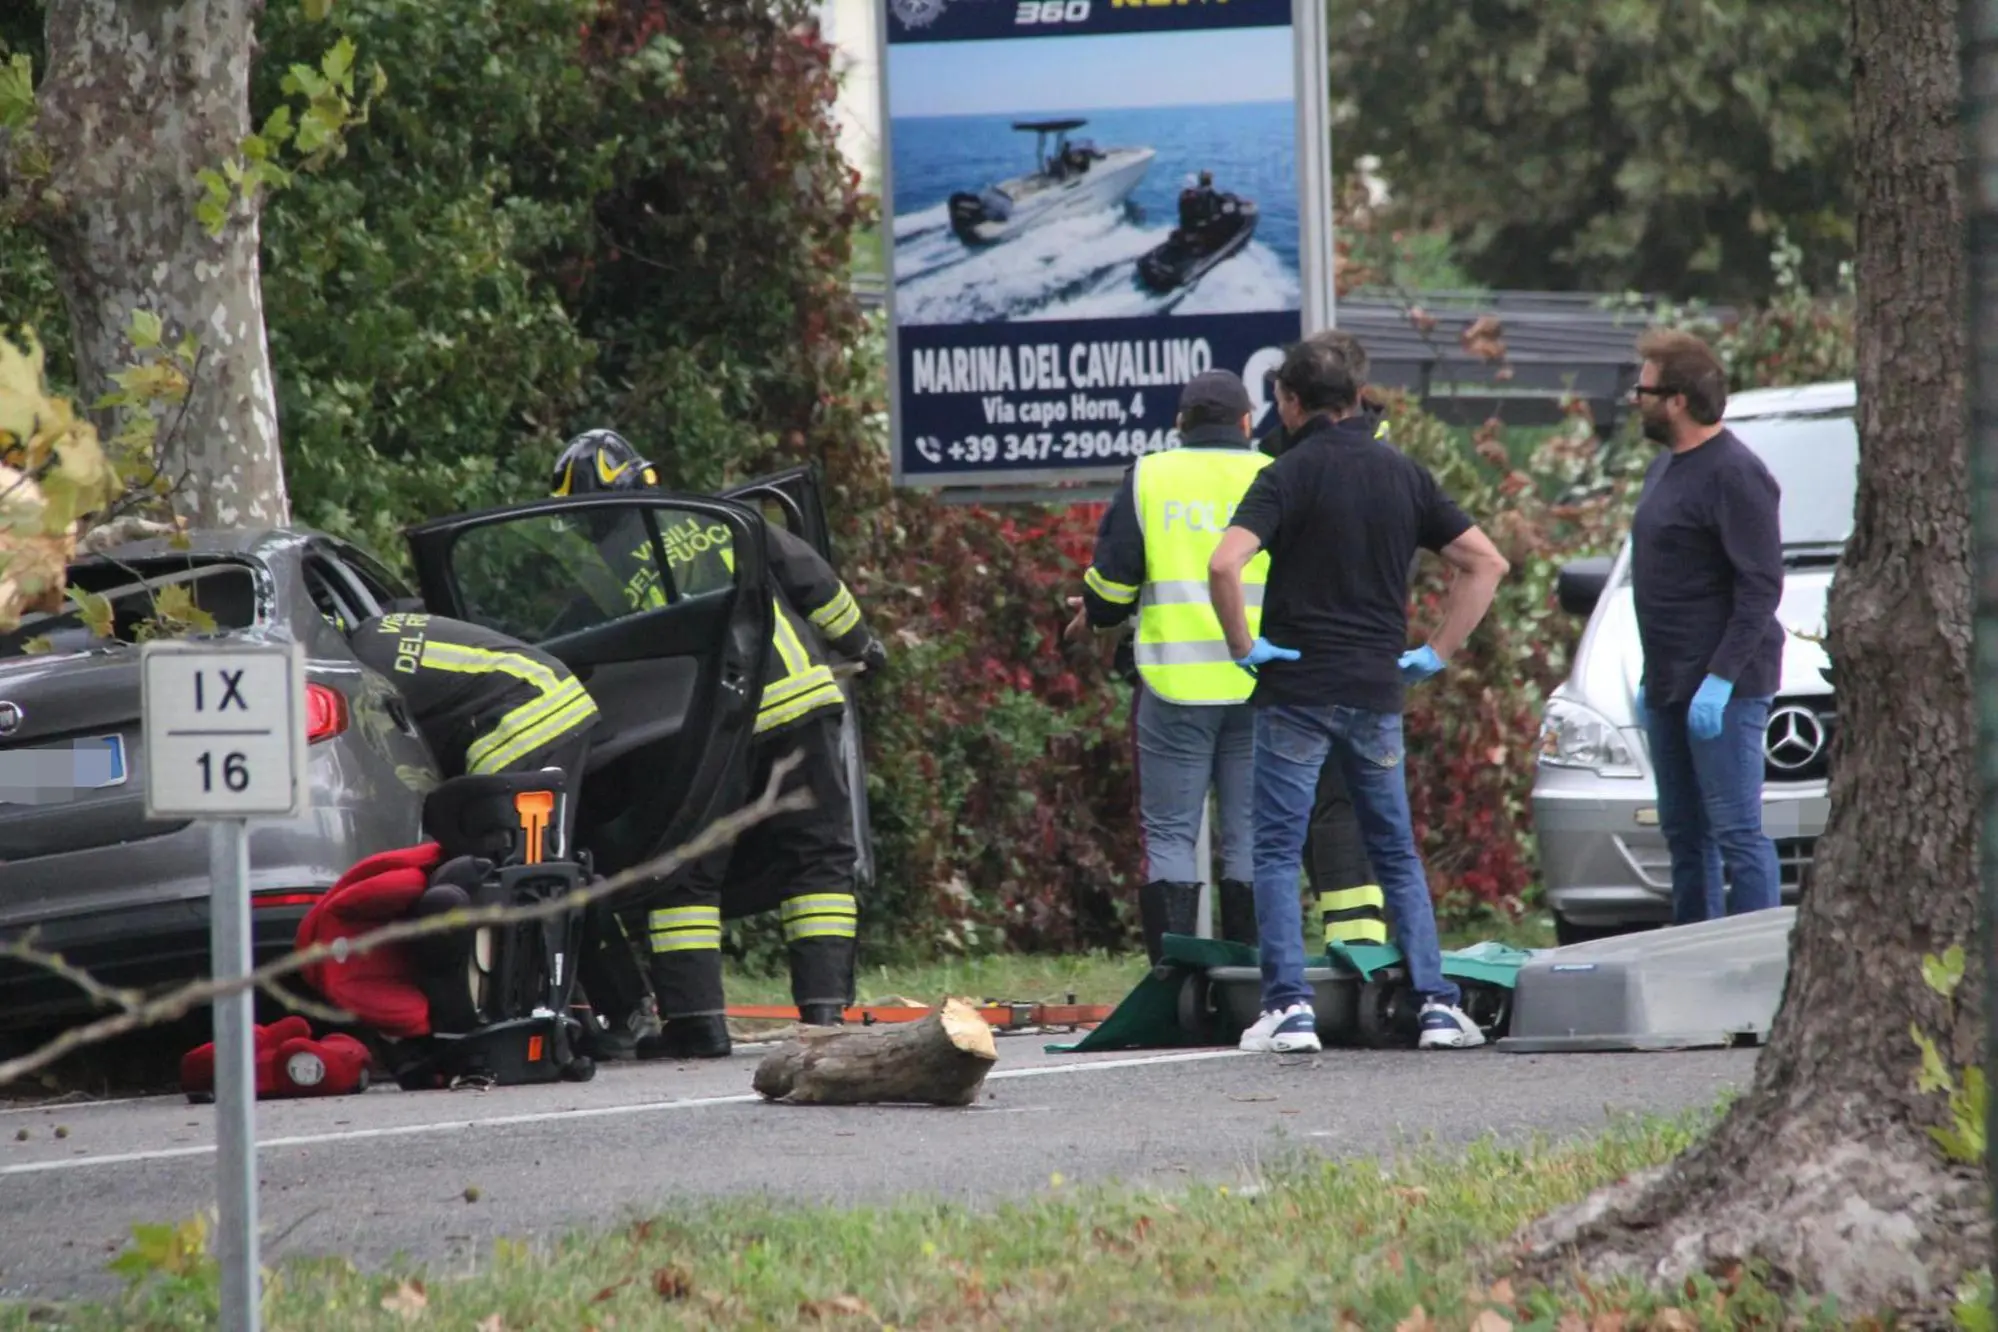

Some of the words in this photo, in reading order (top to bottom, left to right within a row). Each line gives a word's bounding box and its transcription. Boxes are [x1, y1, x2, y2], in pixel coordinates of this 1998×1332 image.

[1014, 0, 1091, 25] 360
[913, 345, 1016, 394] MARINA
[1018, 342, 1067, 391] DEL
[1069, 337, 1212, 389] CAVALLINO
[982, 394, 1016, 424] Via
[1019, 400, 1068, 429] capo
[1071, 392, 1127, 425] Horn,
[1130, 391, 1145, 419] 4
[947, 433, 998, 462] +39
[1004, 427, 1182, 460] 347-2904846
[394, 630, 424, 674] DEL
[195, 669, 248, 712] IX
[196, 750, 249, 793] 16
